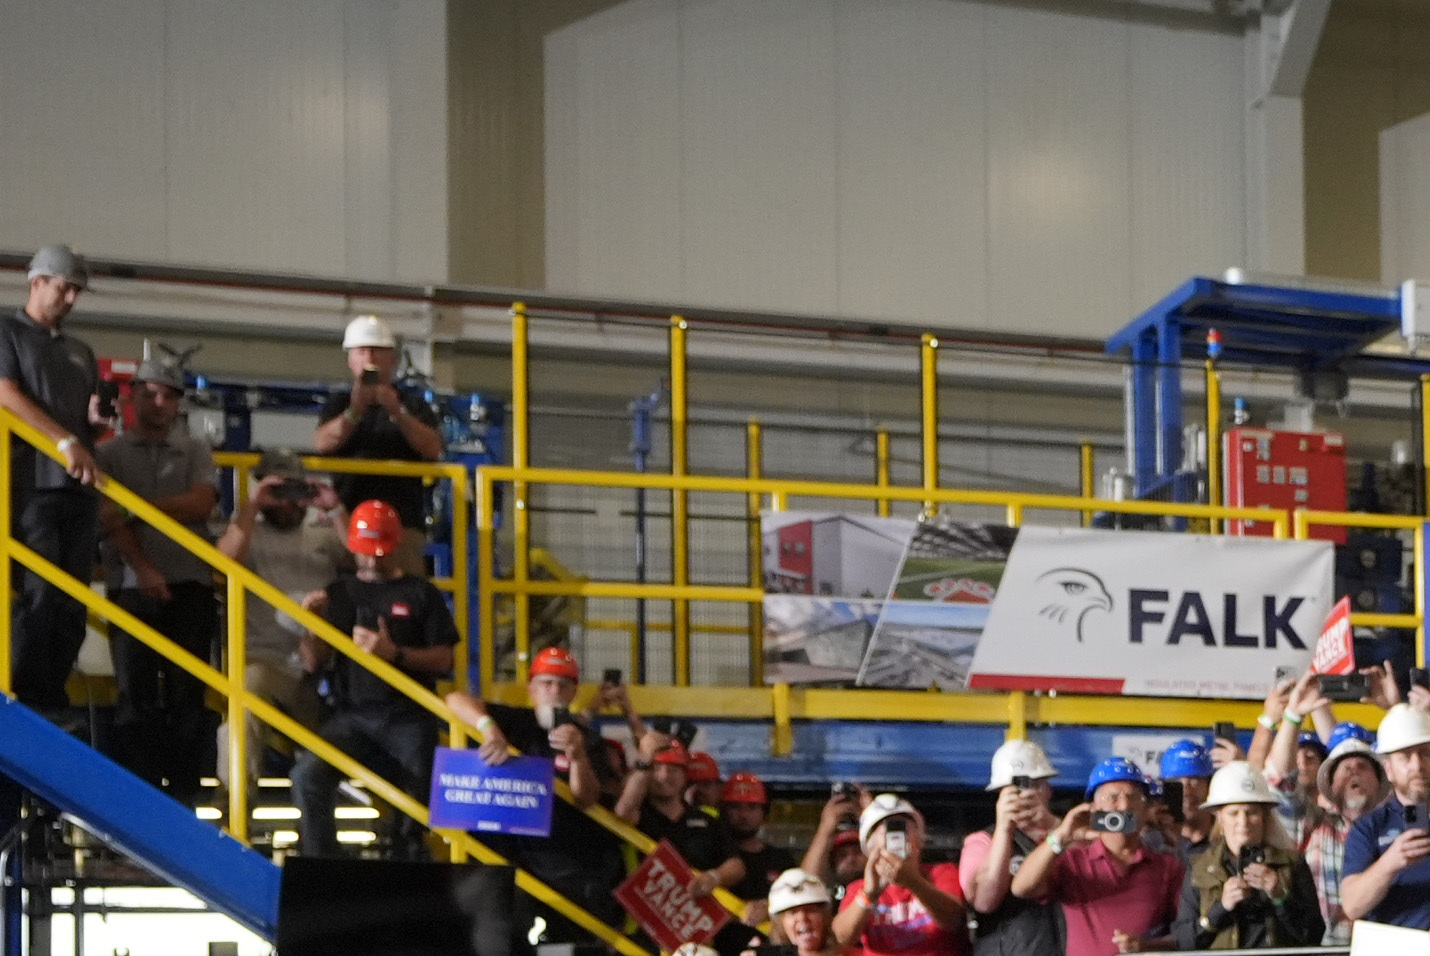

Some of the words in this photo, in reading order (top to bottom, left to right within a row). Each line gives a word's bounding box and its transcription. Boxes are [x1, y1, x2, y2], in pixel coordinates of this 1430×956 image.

[1128, 587, 1307, 650] FALK
[1199, 680, 1229, 690] METAL
[440, 772, 481, 790] MAKE
[481, 776, 548, 796] AMERICA
[444, 788, 492, 806] GREAT
[492, 792, 540, 809] AGAIN
[643, 878, 693, 938] VANCE
[647, 857, 714, 932] TRUMP
